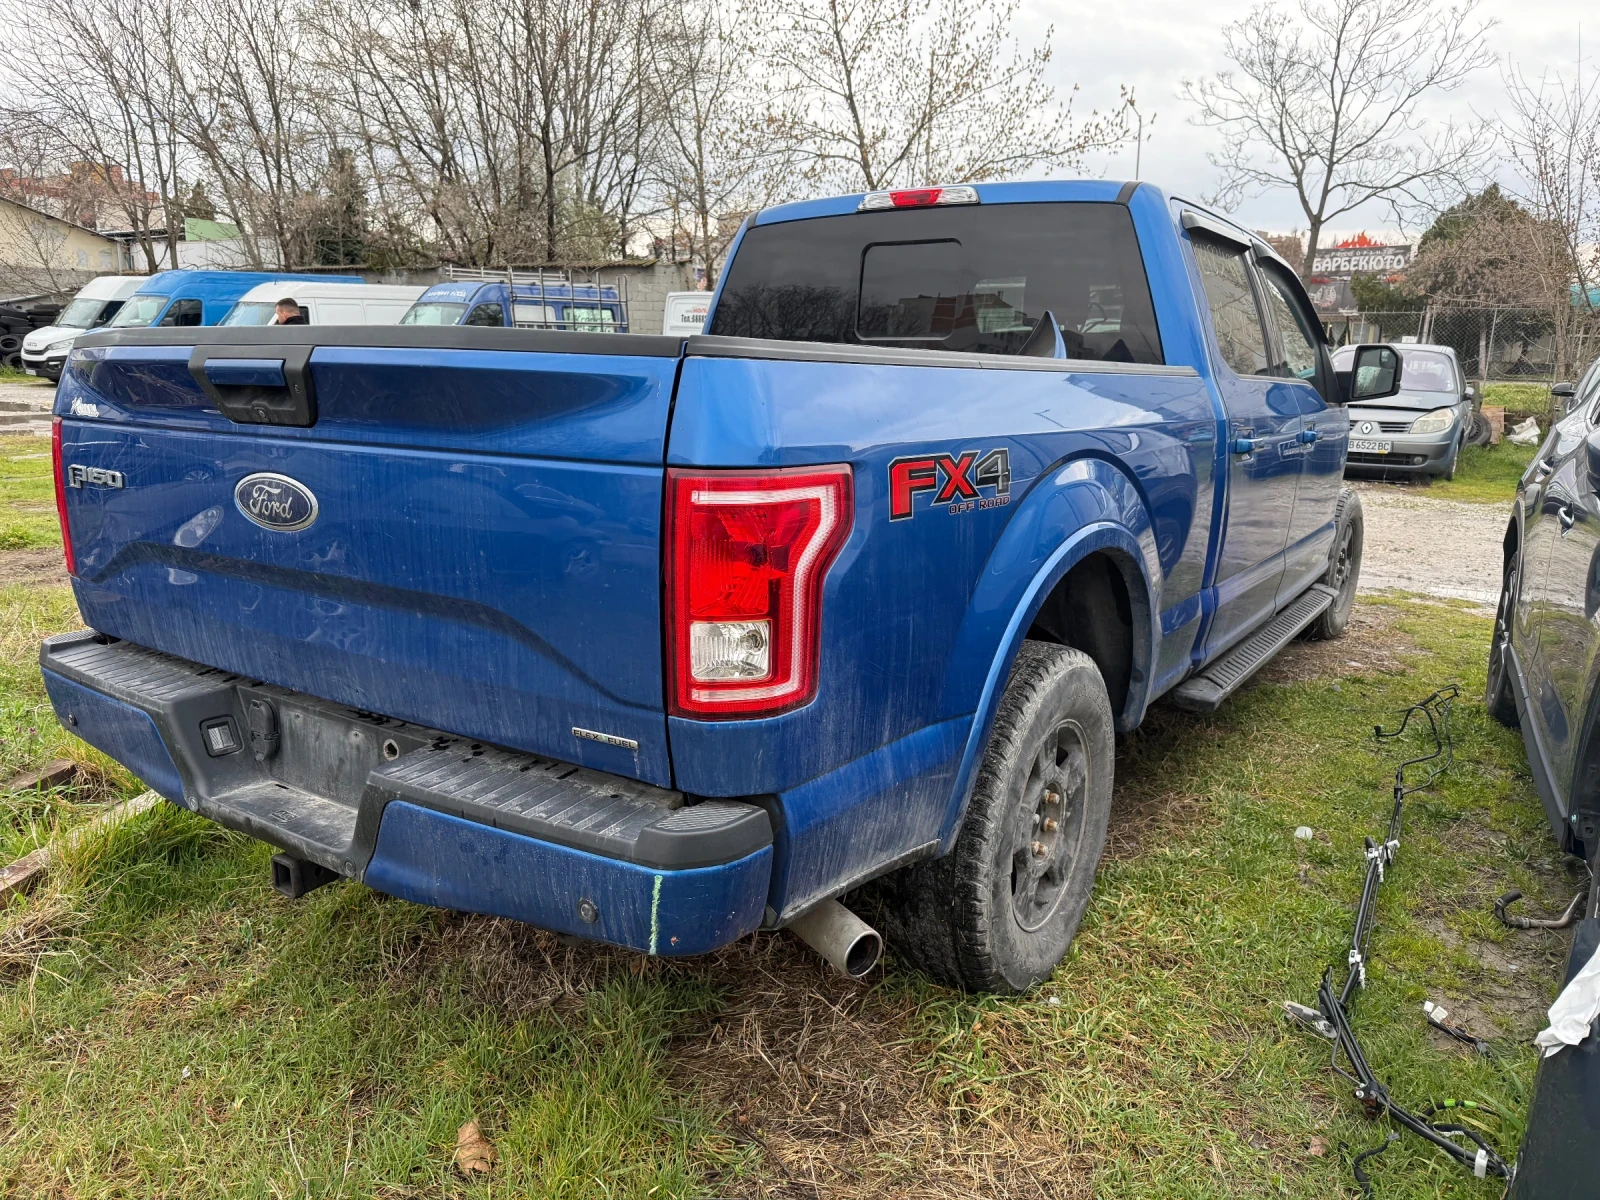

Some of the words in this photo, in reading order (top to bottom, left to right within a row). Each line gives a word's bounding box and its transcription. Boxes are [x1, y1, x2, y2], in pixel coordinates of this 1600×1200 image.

[1312, 255, 1405, 272] БАРБЕКЮТО
[1355, 442, 1377, 450] 6522
[1378, 442, 1390, 451] BC
[887, 447, 1012, 523] FX4
[249, 484, 293, 519] Ford
[949, 501, 975, 515] OFF
[979, 495, 1011, 511] ROAD
[573, 729, 600, 741] FLEX
[606, 737, 635, 749] FUEL
